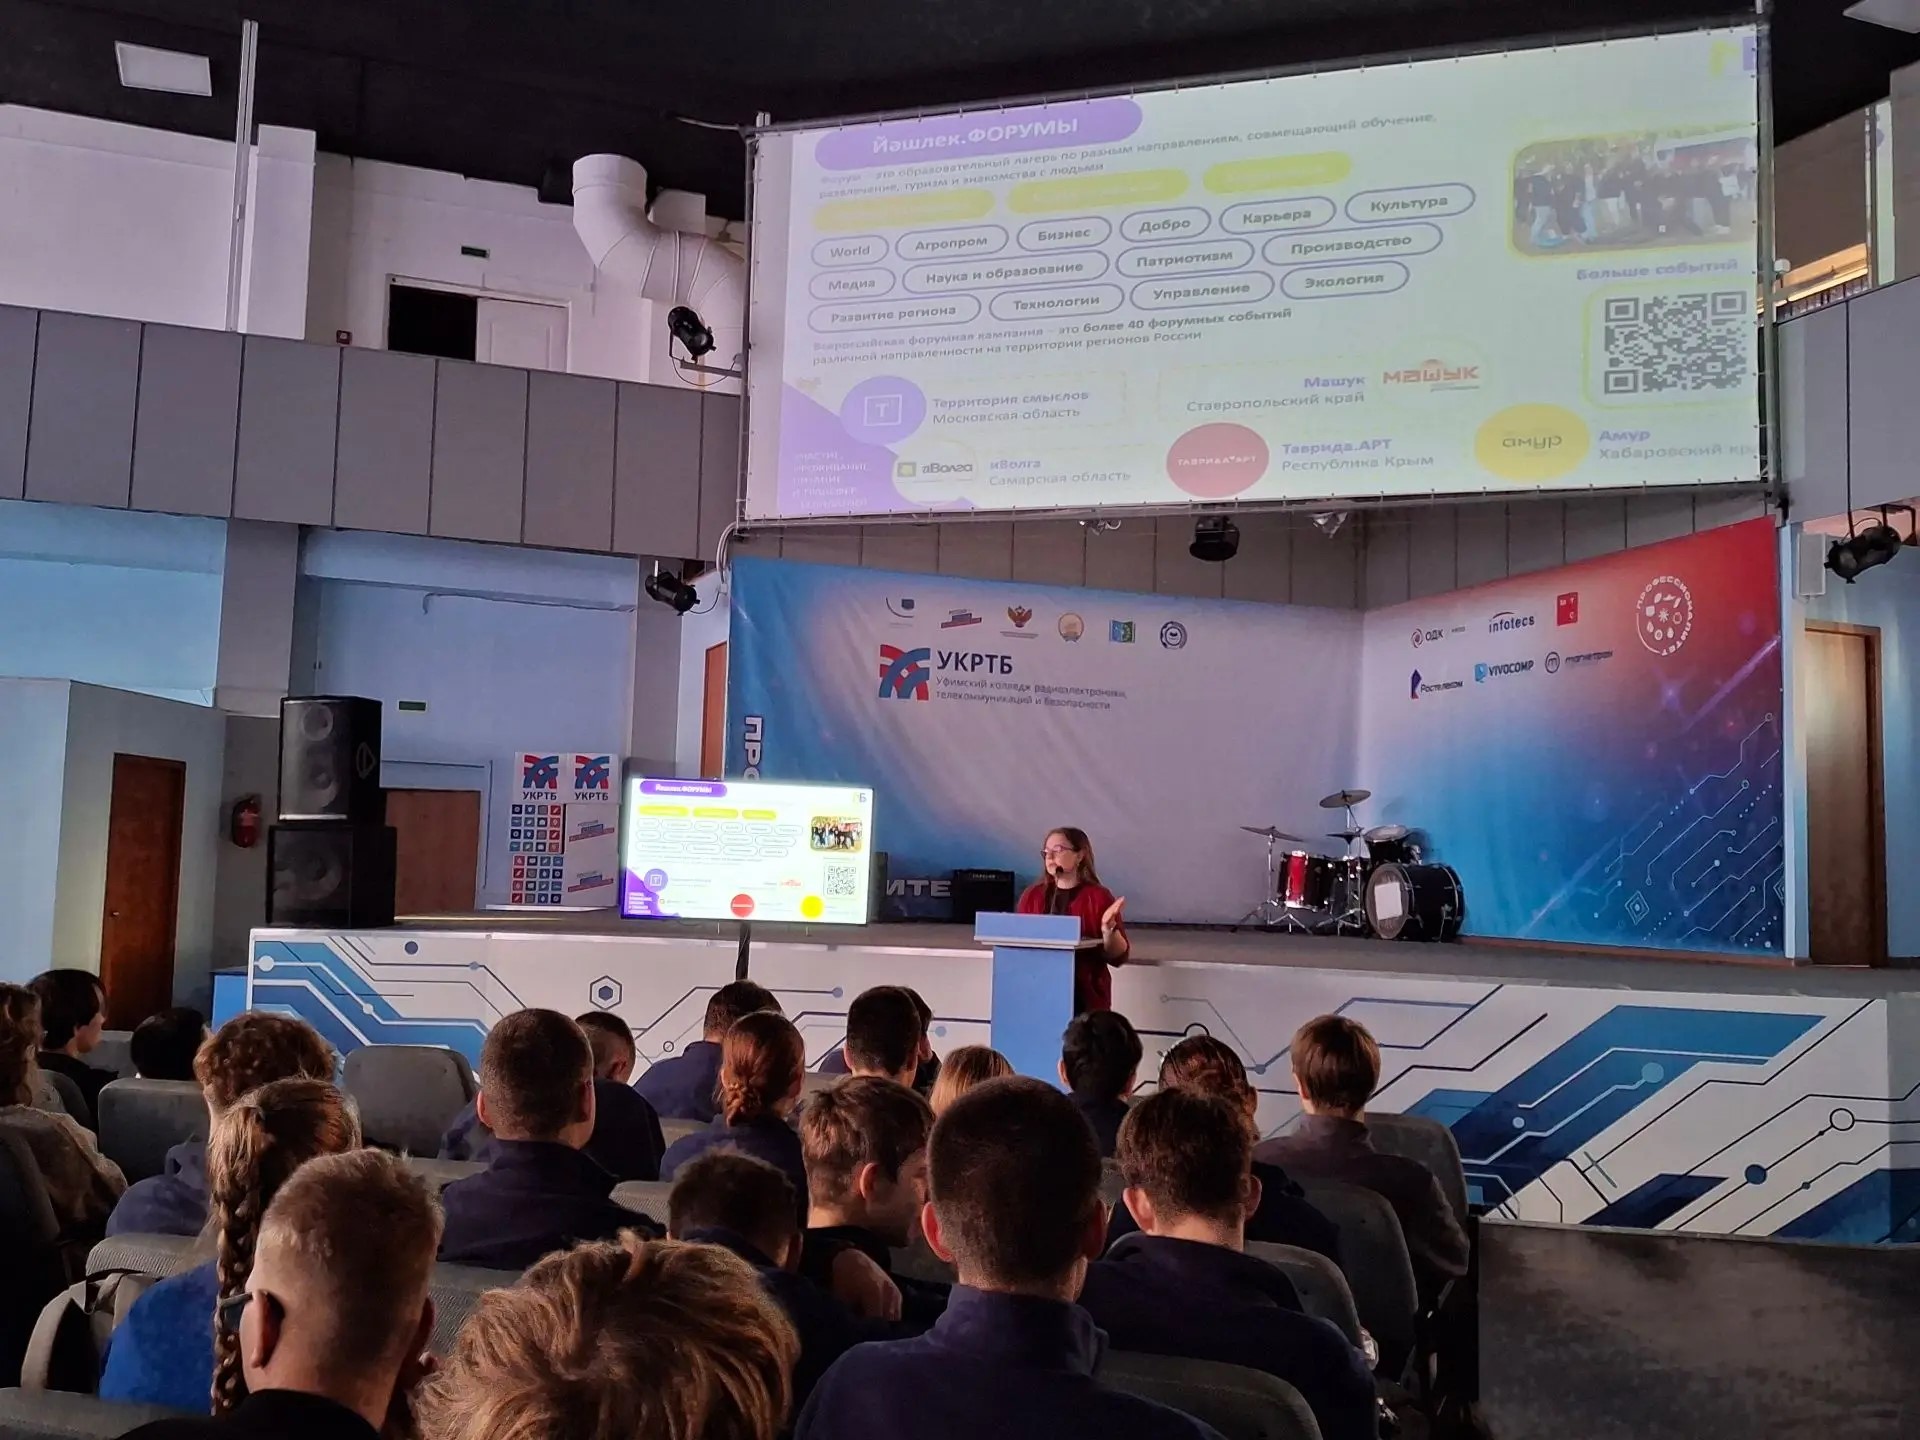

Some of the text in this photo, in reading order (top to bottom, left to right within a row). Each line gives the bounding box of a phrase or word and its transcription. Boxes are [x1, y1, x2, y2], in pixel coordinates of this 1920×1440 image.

[898, 157, 1010, 178] образовательный
[1014, 152, 1057, 167] лагерь
[1061, 151, 1078, 162] по
[1081, 145, 1133, 161] разным
[1137, 133, 1243, 153] направлениям,
[1247, 119, 1356, 142] совмещающий
[904, 177, 948, 193] туризм
[952, 177, 960, 186] и
[963, 168, 1036, 184] знакомства
[1040, 168, 1047, 177] с
[1050, 161, 1104, 177] людьми
[1370, 194, 1448, 214] Культура
[1138, 217, 1191, 235] Добро
[1242, 208, 1312, 226] Карьера
[1037, 227, 1091, 242] Бизнес
[829, 244, 871, 259] World
[915, 235, 988, 254] Агропром
[1290, 234, 1412, 256] Производство
[1136, 249, 1233, 269] Патриотизм
[926, 261, 1084, 287] Наука и образование
[1576, 257, 1739, 282] Больше событий
[827, 278, 876, 292] Медиа
[1304, 272, 1384, 290] Экология
[1153, 282, 1251, 301] Управление
[1013, 295, 1100, 312] Технологии
[831, 306, 957, 324] Развитие региона
[813, 336, 905, 352] Всероссийская
[908, 333, 975, 348] форумная
[978, 327, 1044, 341] кампания
[1058, 325, 1079, 335] это
[1083, 320, 1124, 333] более
[1127, 319, 1144, 330] 40
[1148, 313, 1225, 331] форумных
[1228, 307, 1293, 323] событий
[812, 330, 1202, 366] различной направленности на территории регионов России
[1304, 374, 1366, 390] Машук
[932, 390, 1090, 409] Территория смыслов
[1186, 391, 1365, 413] Ставропольский край
[932, 406, 1081, 425] Московская область
[1599, 429, 1651, 444] Амур
[1282, 437, 1392, 457] Таврида.АРТ
[1599, 443, 1723, 460] Хабаровский
[1282, 455, 1435, 474] Республика Крым
[989, 474, 1070, 487] Самарская
[1073, 470, 1131, 484] область
[1488, 616, 1535, 634] infotecs
[936, 649, 1014, 675] УКРТБ
[1488, 660, 1535, 677] VIVOCOMP
[936, 675, 988, 691] Уфимский
[989, 679, 1032, 693] колледж
[1420, 680, 1464, 693] Ростелеком
[935, 690, 1111, 711] телекоммуникаций и безопасности
[522, 791, 557, 801] УКРТБ
[574, 791, 609, 801] УКРТБ
